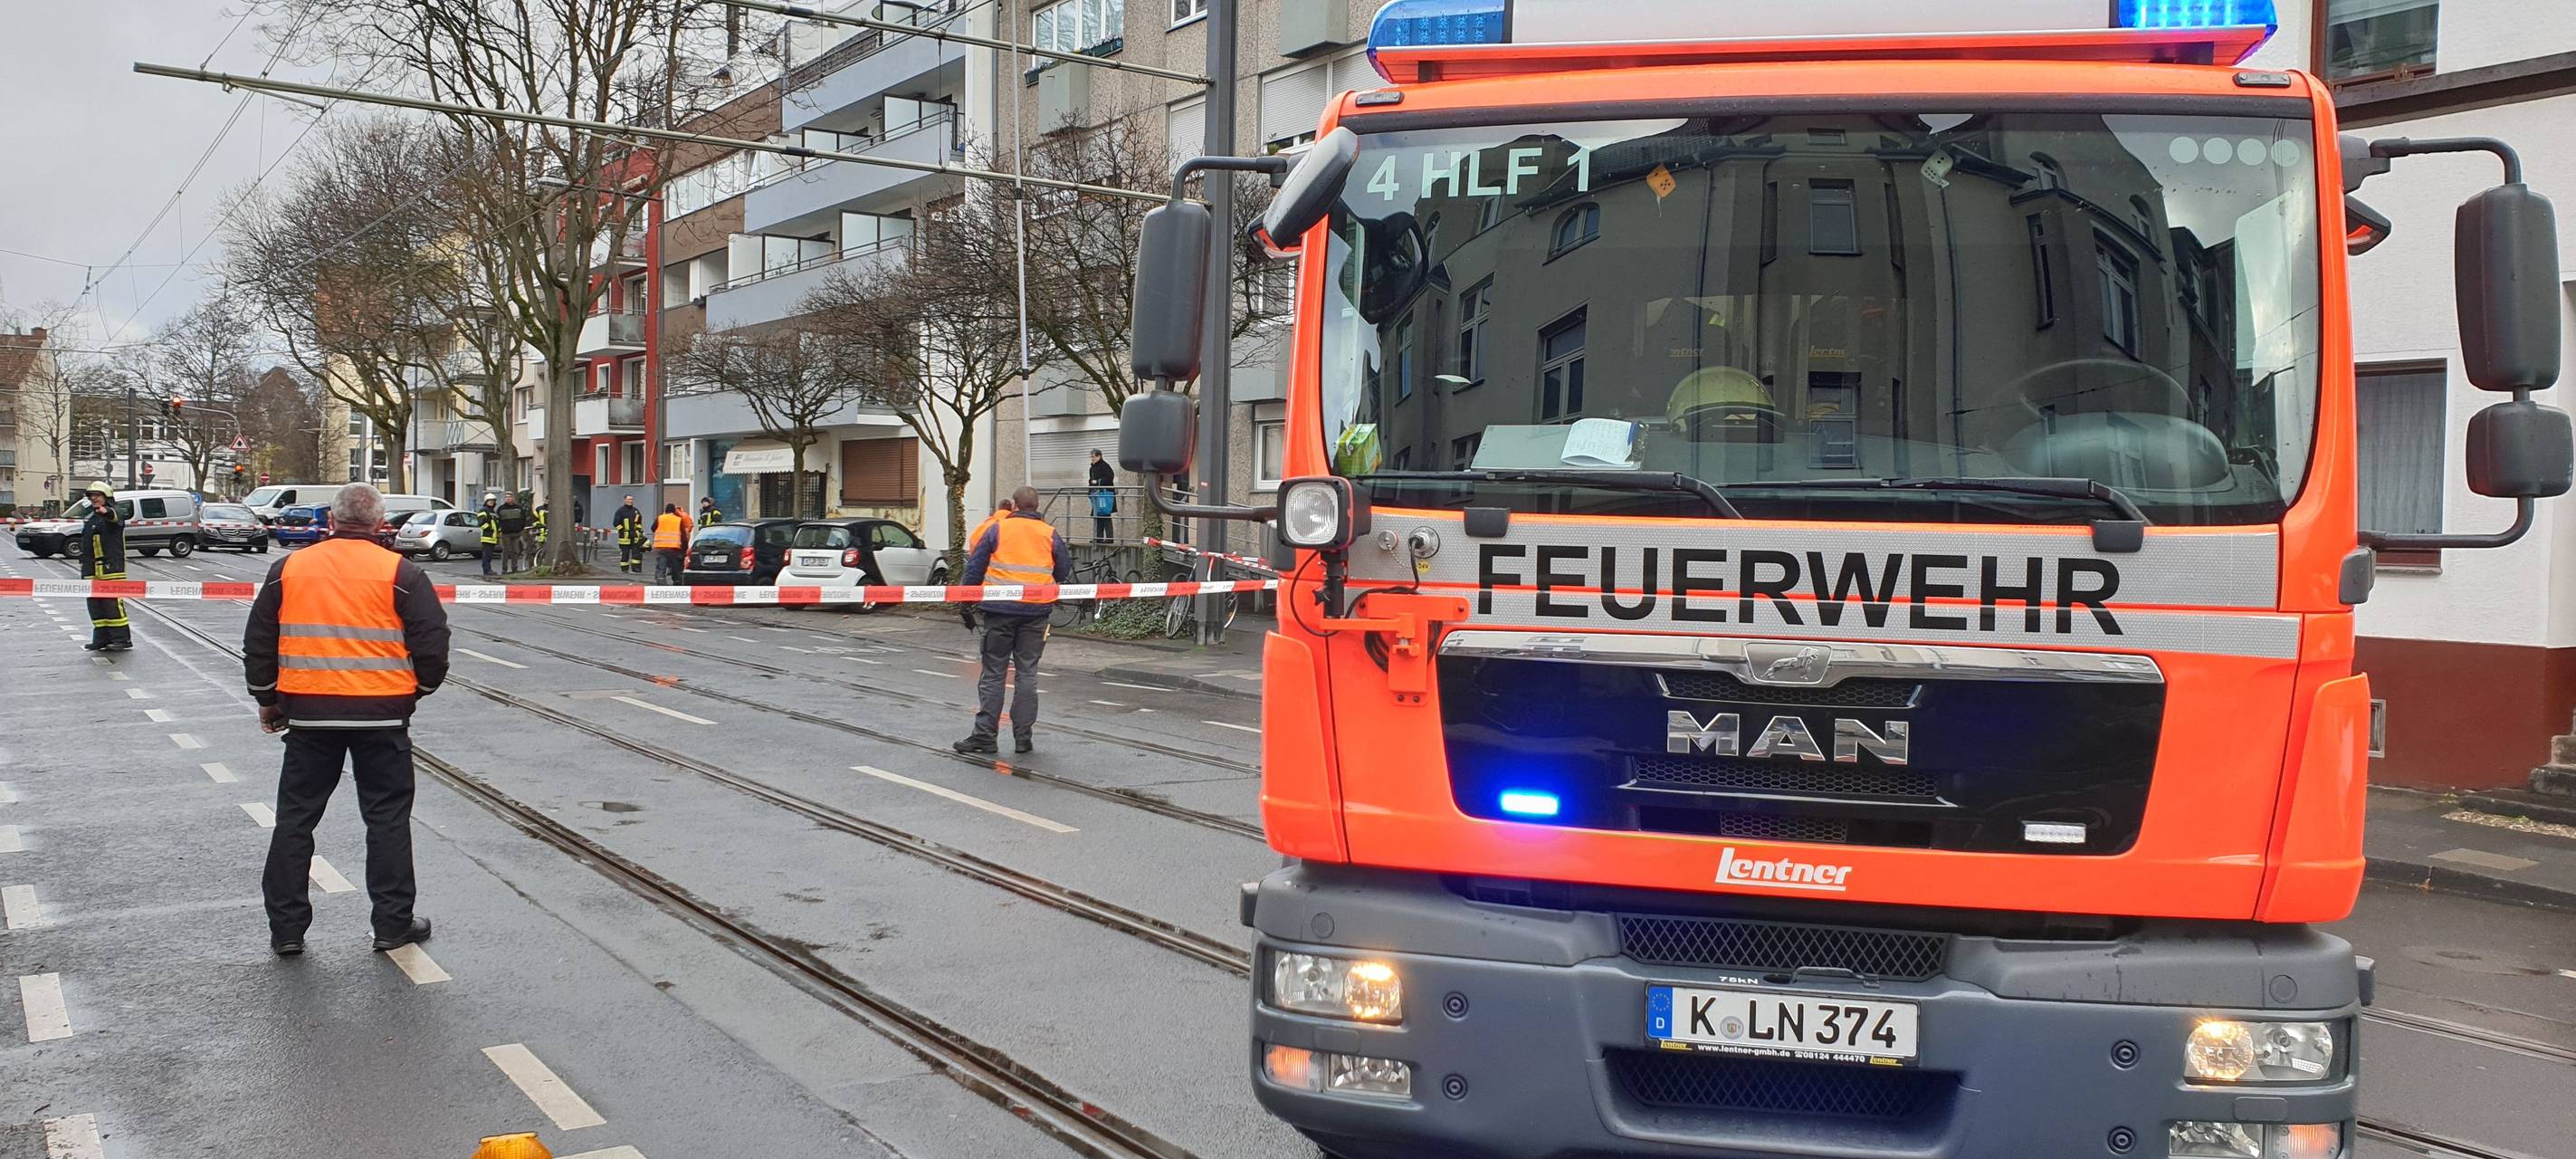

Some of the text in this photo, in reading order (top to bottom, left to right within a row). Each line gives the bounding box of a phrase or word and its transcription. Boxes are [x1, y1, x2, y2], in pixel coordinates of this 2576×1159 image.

[1367, 146, 1590, 201] 4 HLF 1
[1478, 542, 2123, 636] FEUERWEHR
[1667, 710, 1909, 765] MAN
[1655, 1017, 1665, 1030] D
[1691, 996, 1896, 1049] K LN 374
[1697, 1044, 1791, 1058] www.lentner-gmbh.de
[1832, 1054, 1865, 1063] 444470
